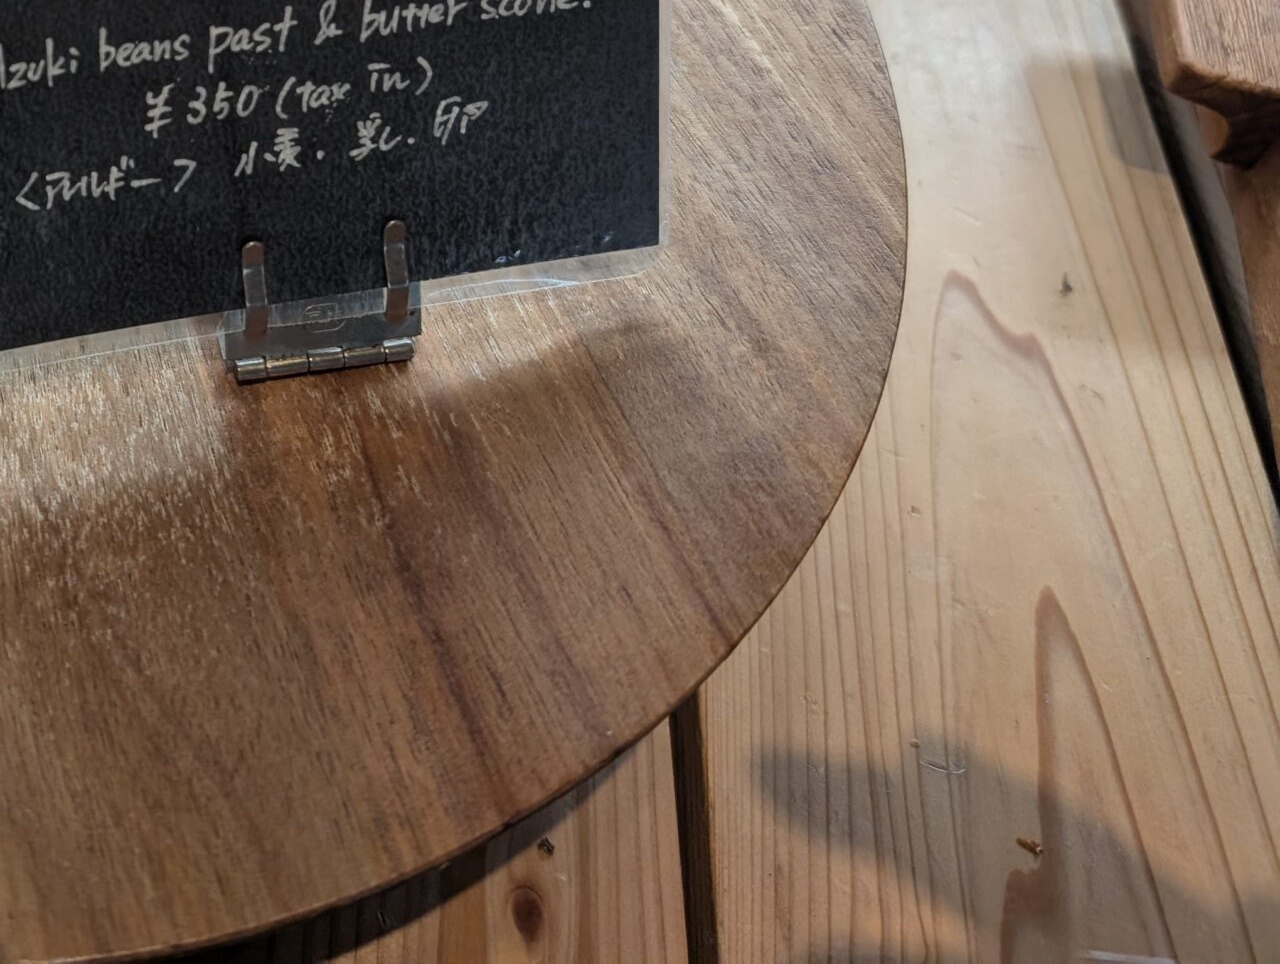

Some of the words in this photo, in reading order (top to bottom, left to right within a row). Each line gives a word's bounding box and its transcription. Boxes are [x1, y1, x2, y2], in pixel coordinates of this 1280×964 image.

[99, 26, 192, 73] beans
[207, 4, 299, 75] past
[275, 75, 352, 120] (tax
[366, 56, 434, 96] in)
